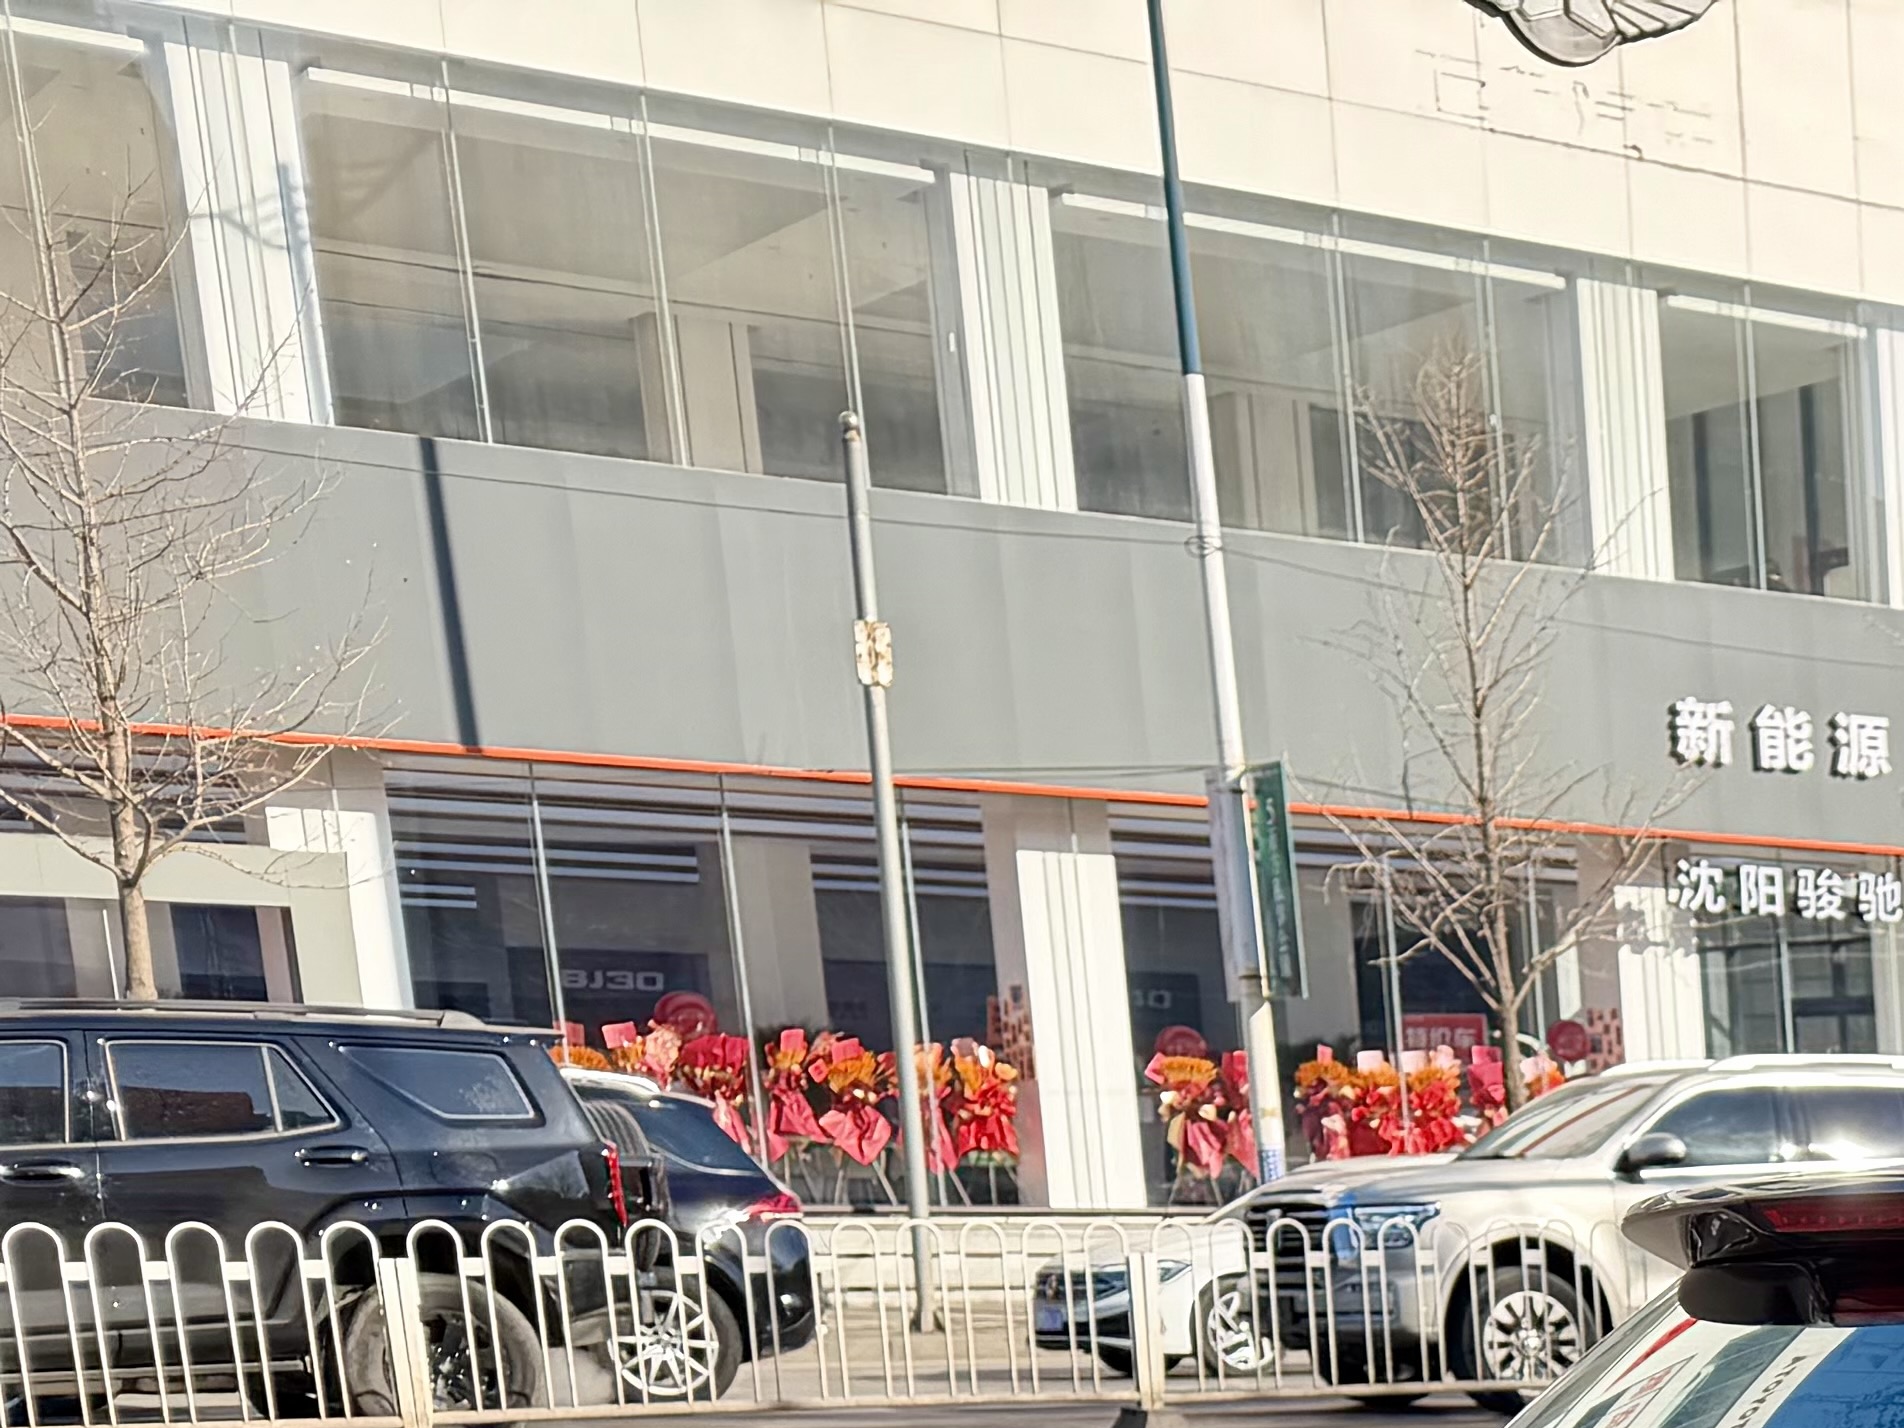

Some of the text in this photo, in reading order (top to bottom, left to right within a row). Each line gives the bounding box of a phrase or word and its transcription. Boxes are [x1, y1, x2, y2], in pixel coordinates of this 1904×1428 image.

[1669, 696, 1893, 779] 新能源
[1667, 858, 1904, 923] 沈阳骏驰
